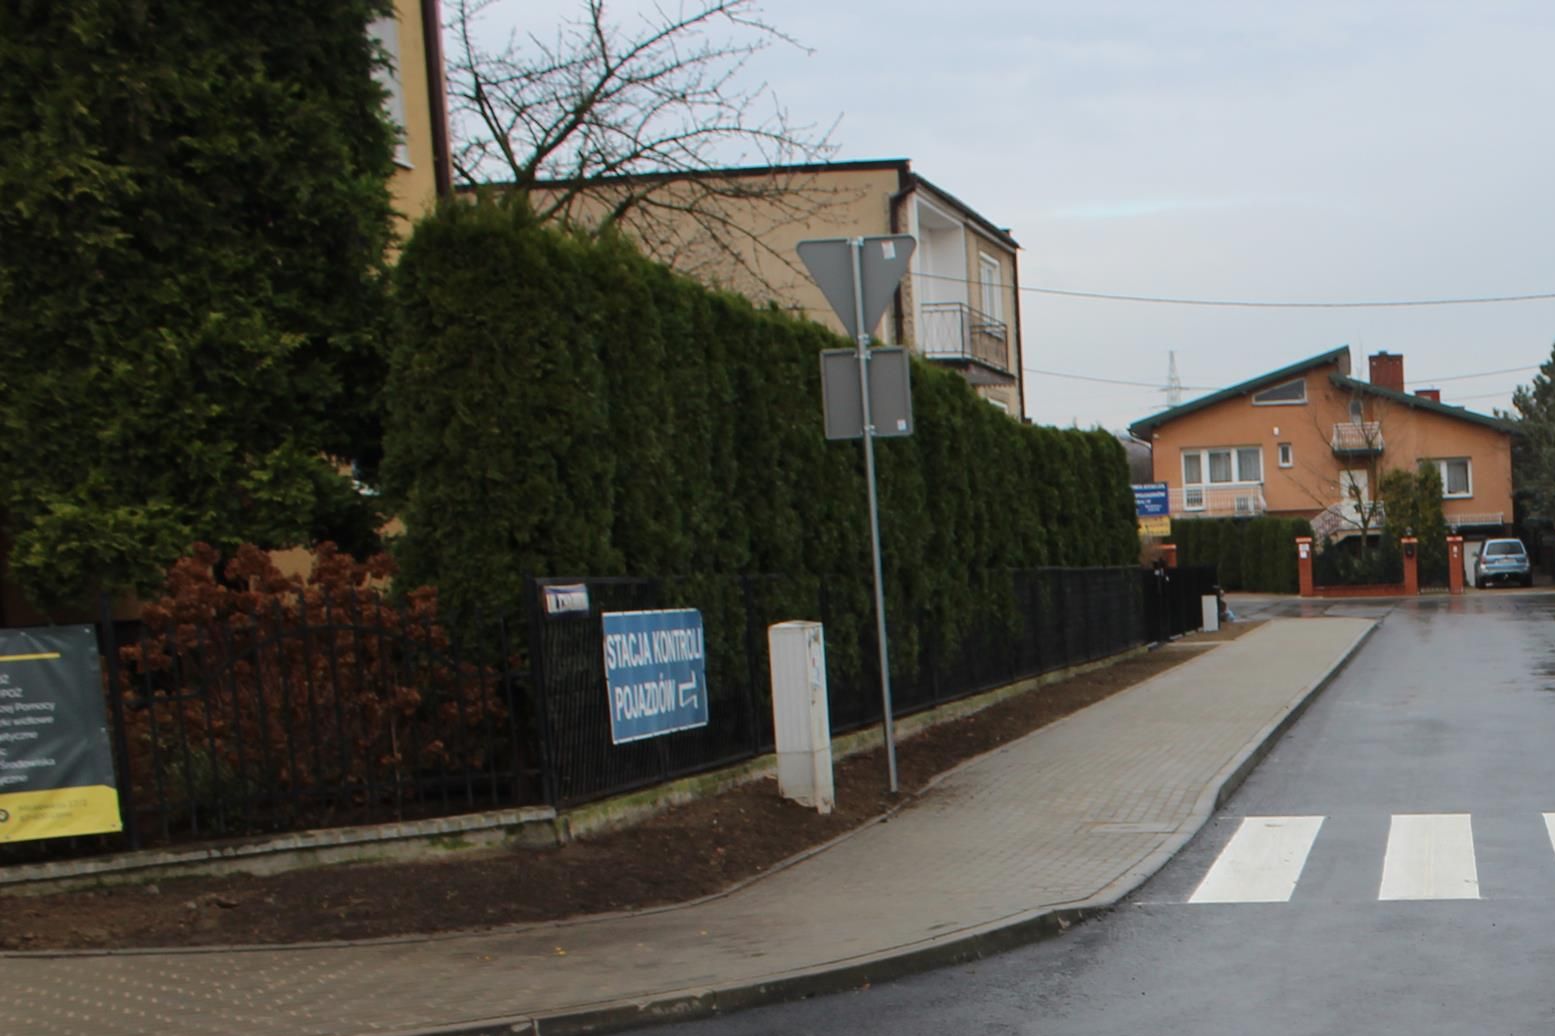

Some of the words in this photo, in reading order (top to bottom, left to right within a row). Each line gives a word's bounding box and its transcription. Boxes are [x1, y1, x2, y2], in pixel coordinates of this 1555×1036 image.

[607, 632, 653, 670] STACJA
[652, 628, 703, 664] KONTROLI
[615, 672, 675, 721] POJAZDÓW
